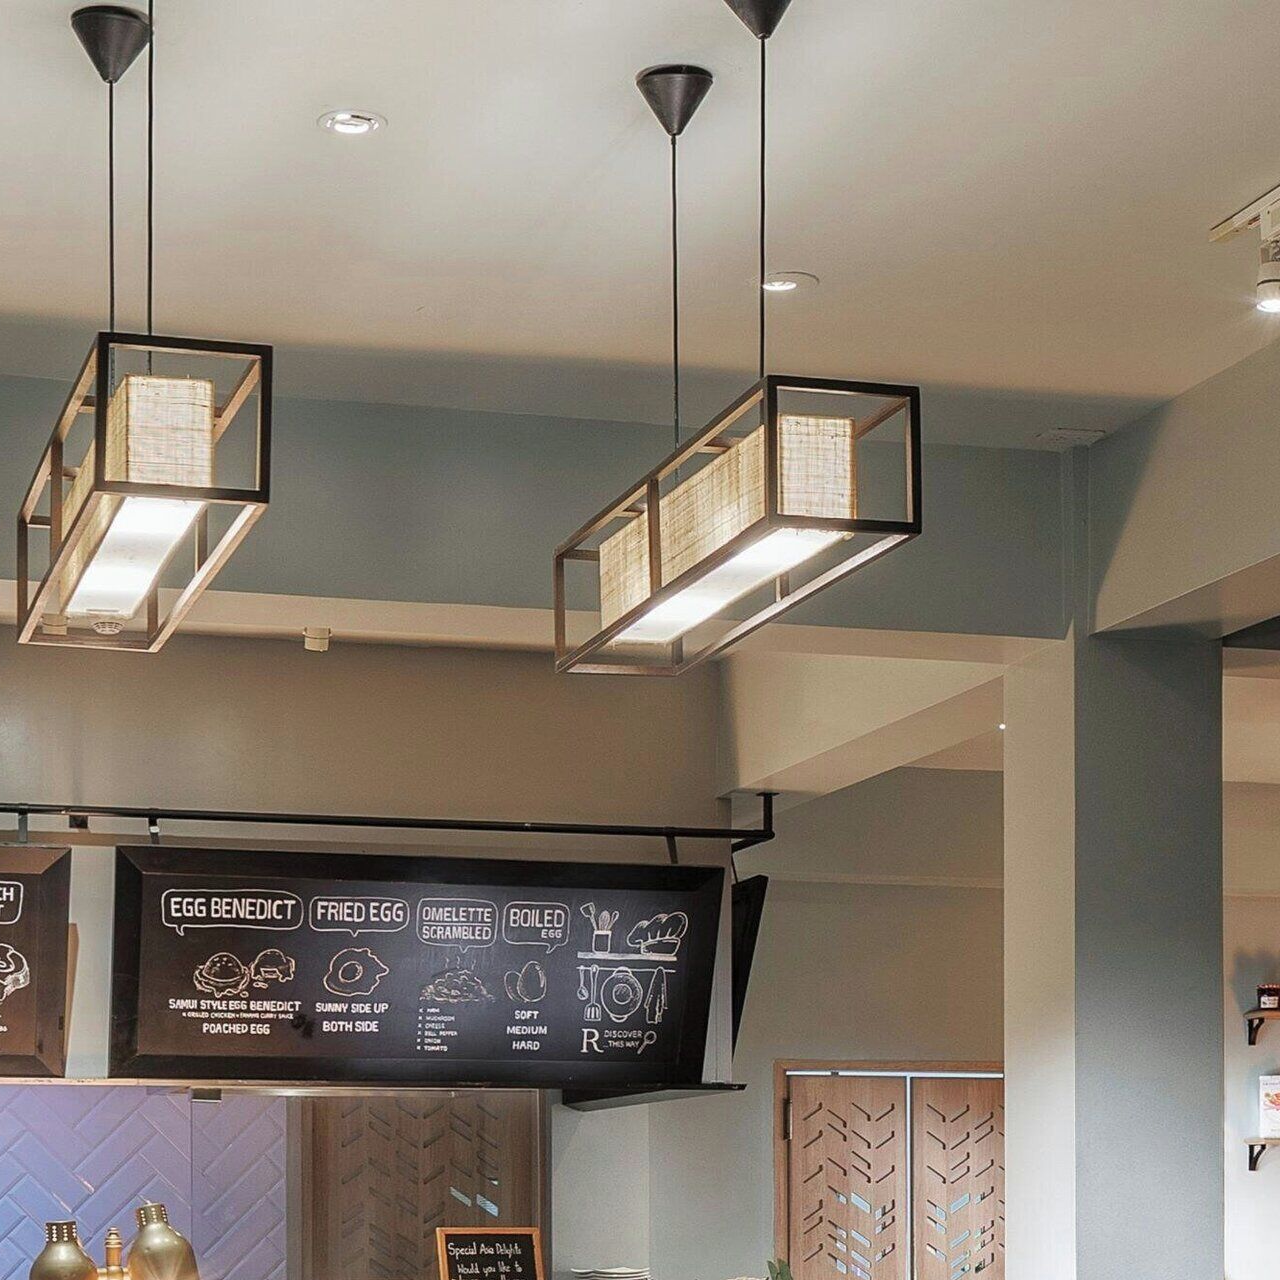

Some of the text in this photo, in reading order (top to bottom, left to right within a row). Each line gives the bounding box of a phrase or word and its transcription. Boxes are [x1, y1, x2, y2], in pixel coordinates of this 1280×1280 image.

[170, 898, 296, 920] EGG BENEDICT
[316, 902, 404, 922] FRIED EGG
[422, 906, 492, 922] OMELETTE
[510, 908, 565, 928] BOILED
[422, 925, 491, 940] SCRAMBLED
[542, 928, 562, 938] EGG
[169, 999, 302, 1011] SAMUI STYLE EGG BENEDICT
[316, 1002, 388, 1014] SUNNY SIDE UP
[514, 1010, 539, 1020] SOFT
[203, 1023, 270, 1034] POACHED EGG
[323, 1021, 379, 1032] BOTH SIDE
[506, 1025, 547, 1035] MEDIUM
[604, 1030, 642, 1038] DISCOVER
[512, 1040, 540, 1051] HARD
[580, 1028, 604, 1053] R
[448, 1241, 477, 1260] Special
[457, 1261, 522, 1277] Would you like to
